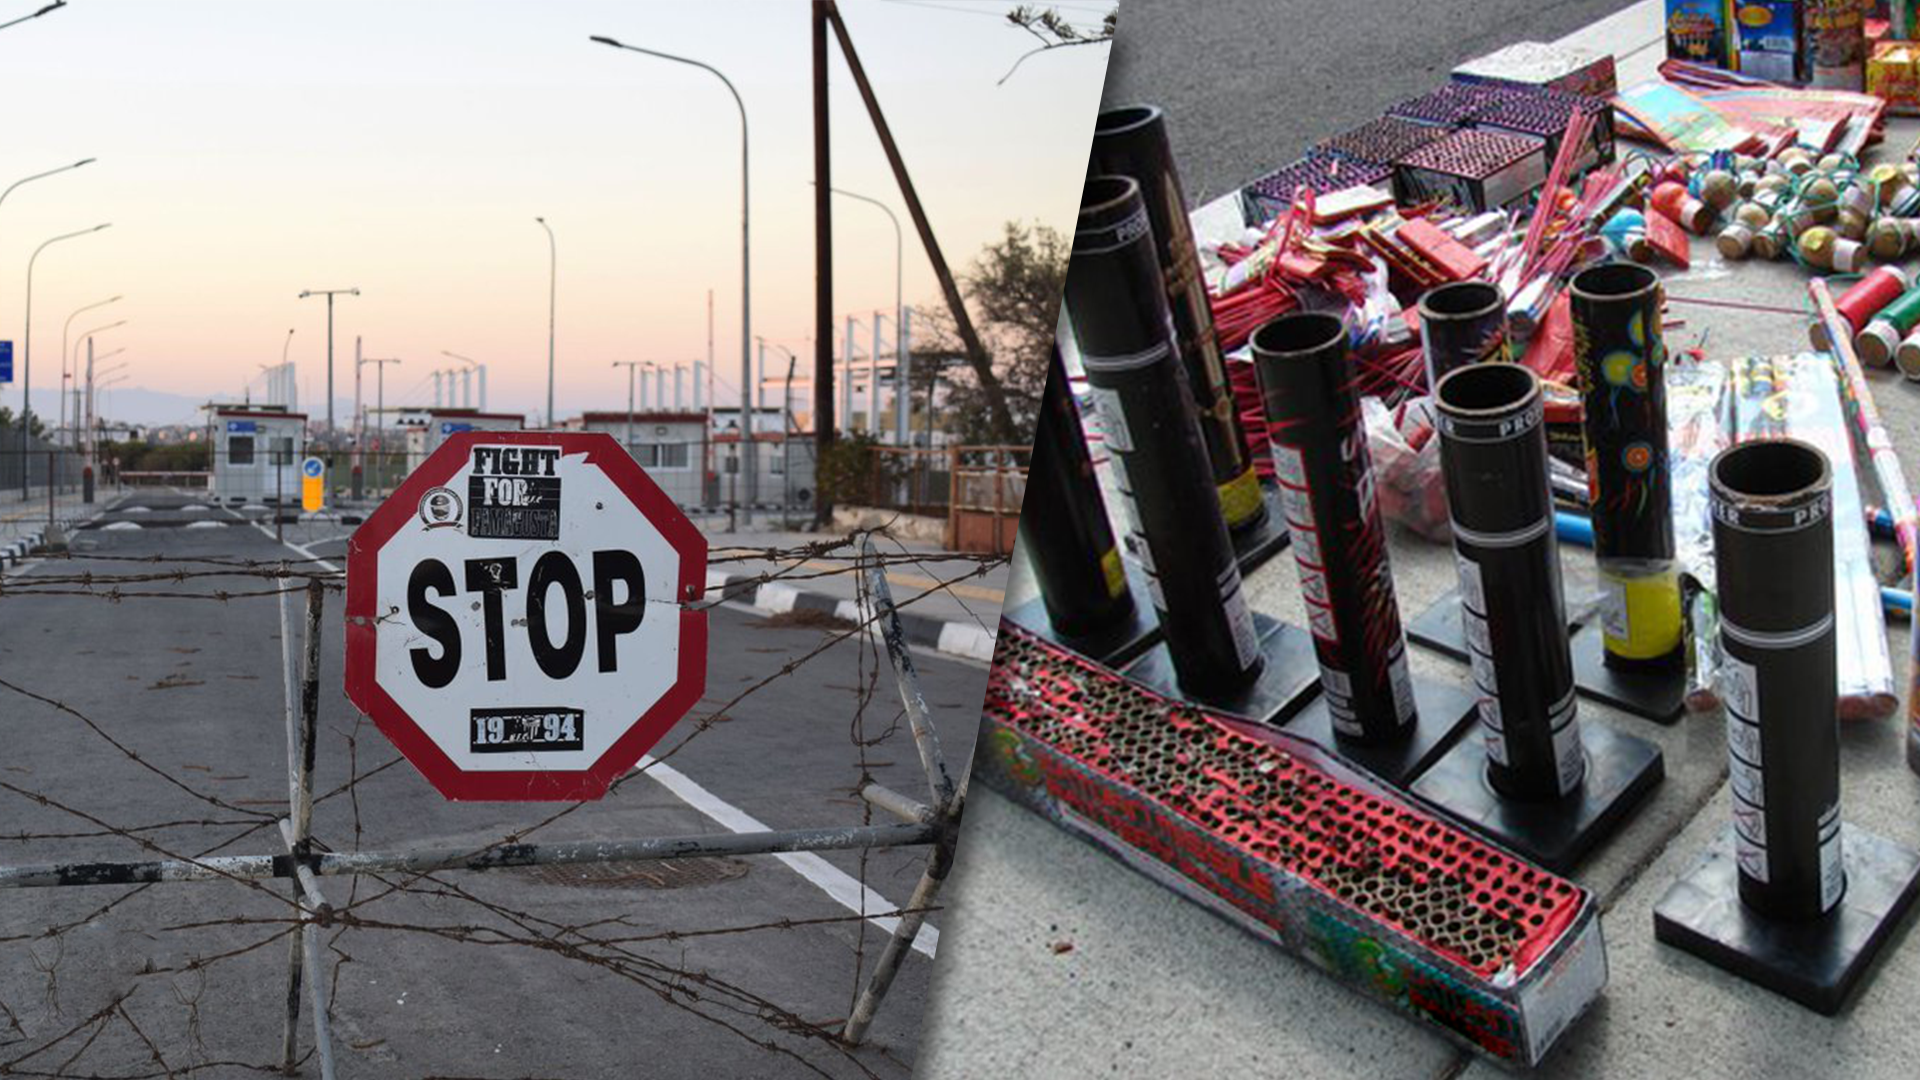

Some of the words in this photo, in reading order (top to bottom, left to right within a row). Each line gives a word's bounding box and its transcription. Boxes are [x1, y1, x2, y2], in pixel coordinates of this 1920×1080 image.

[473, 448, 560, 476] FIGHT
[483, 477, 529, 507] FOR
[470, 507, 559, 539] FAMAGUSTA
[407, 549, 647, 689] STOP
[475, 715, 505, 744] 19
[543, 713, 577, 742] 94
